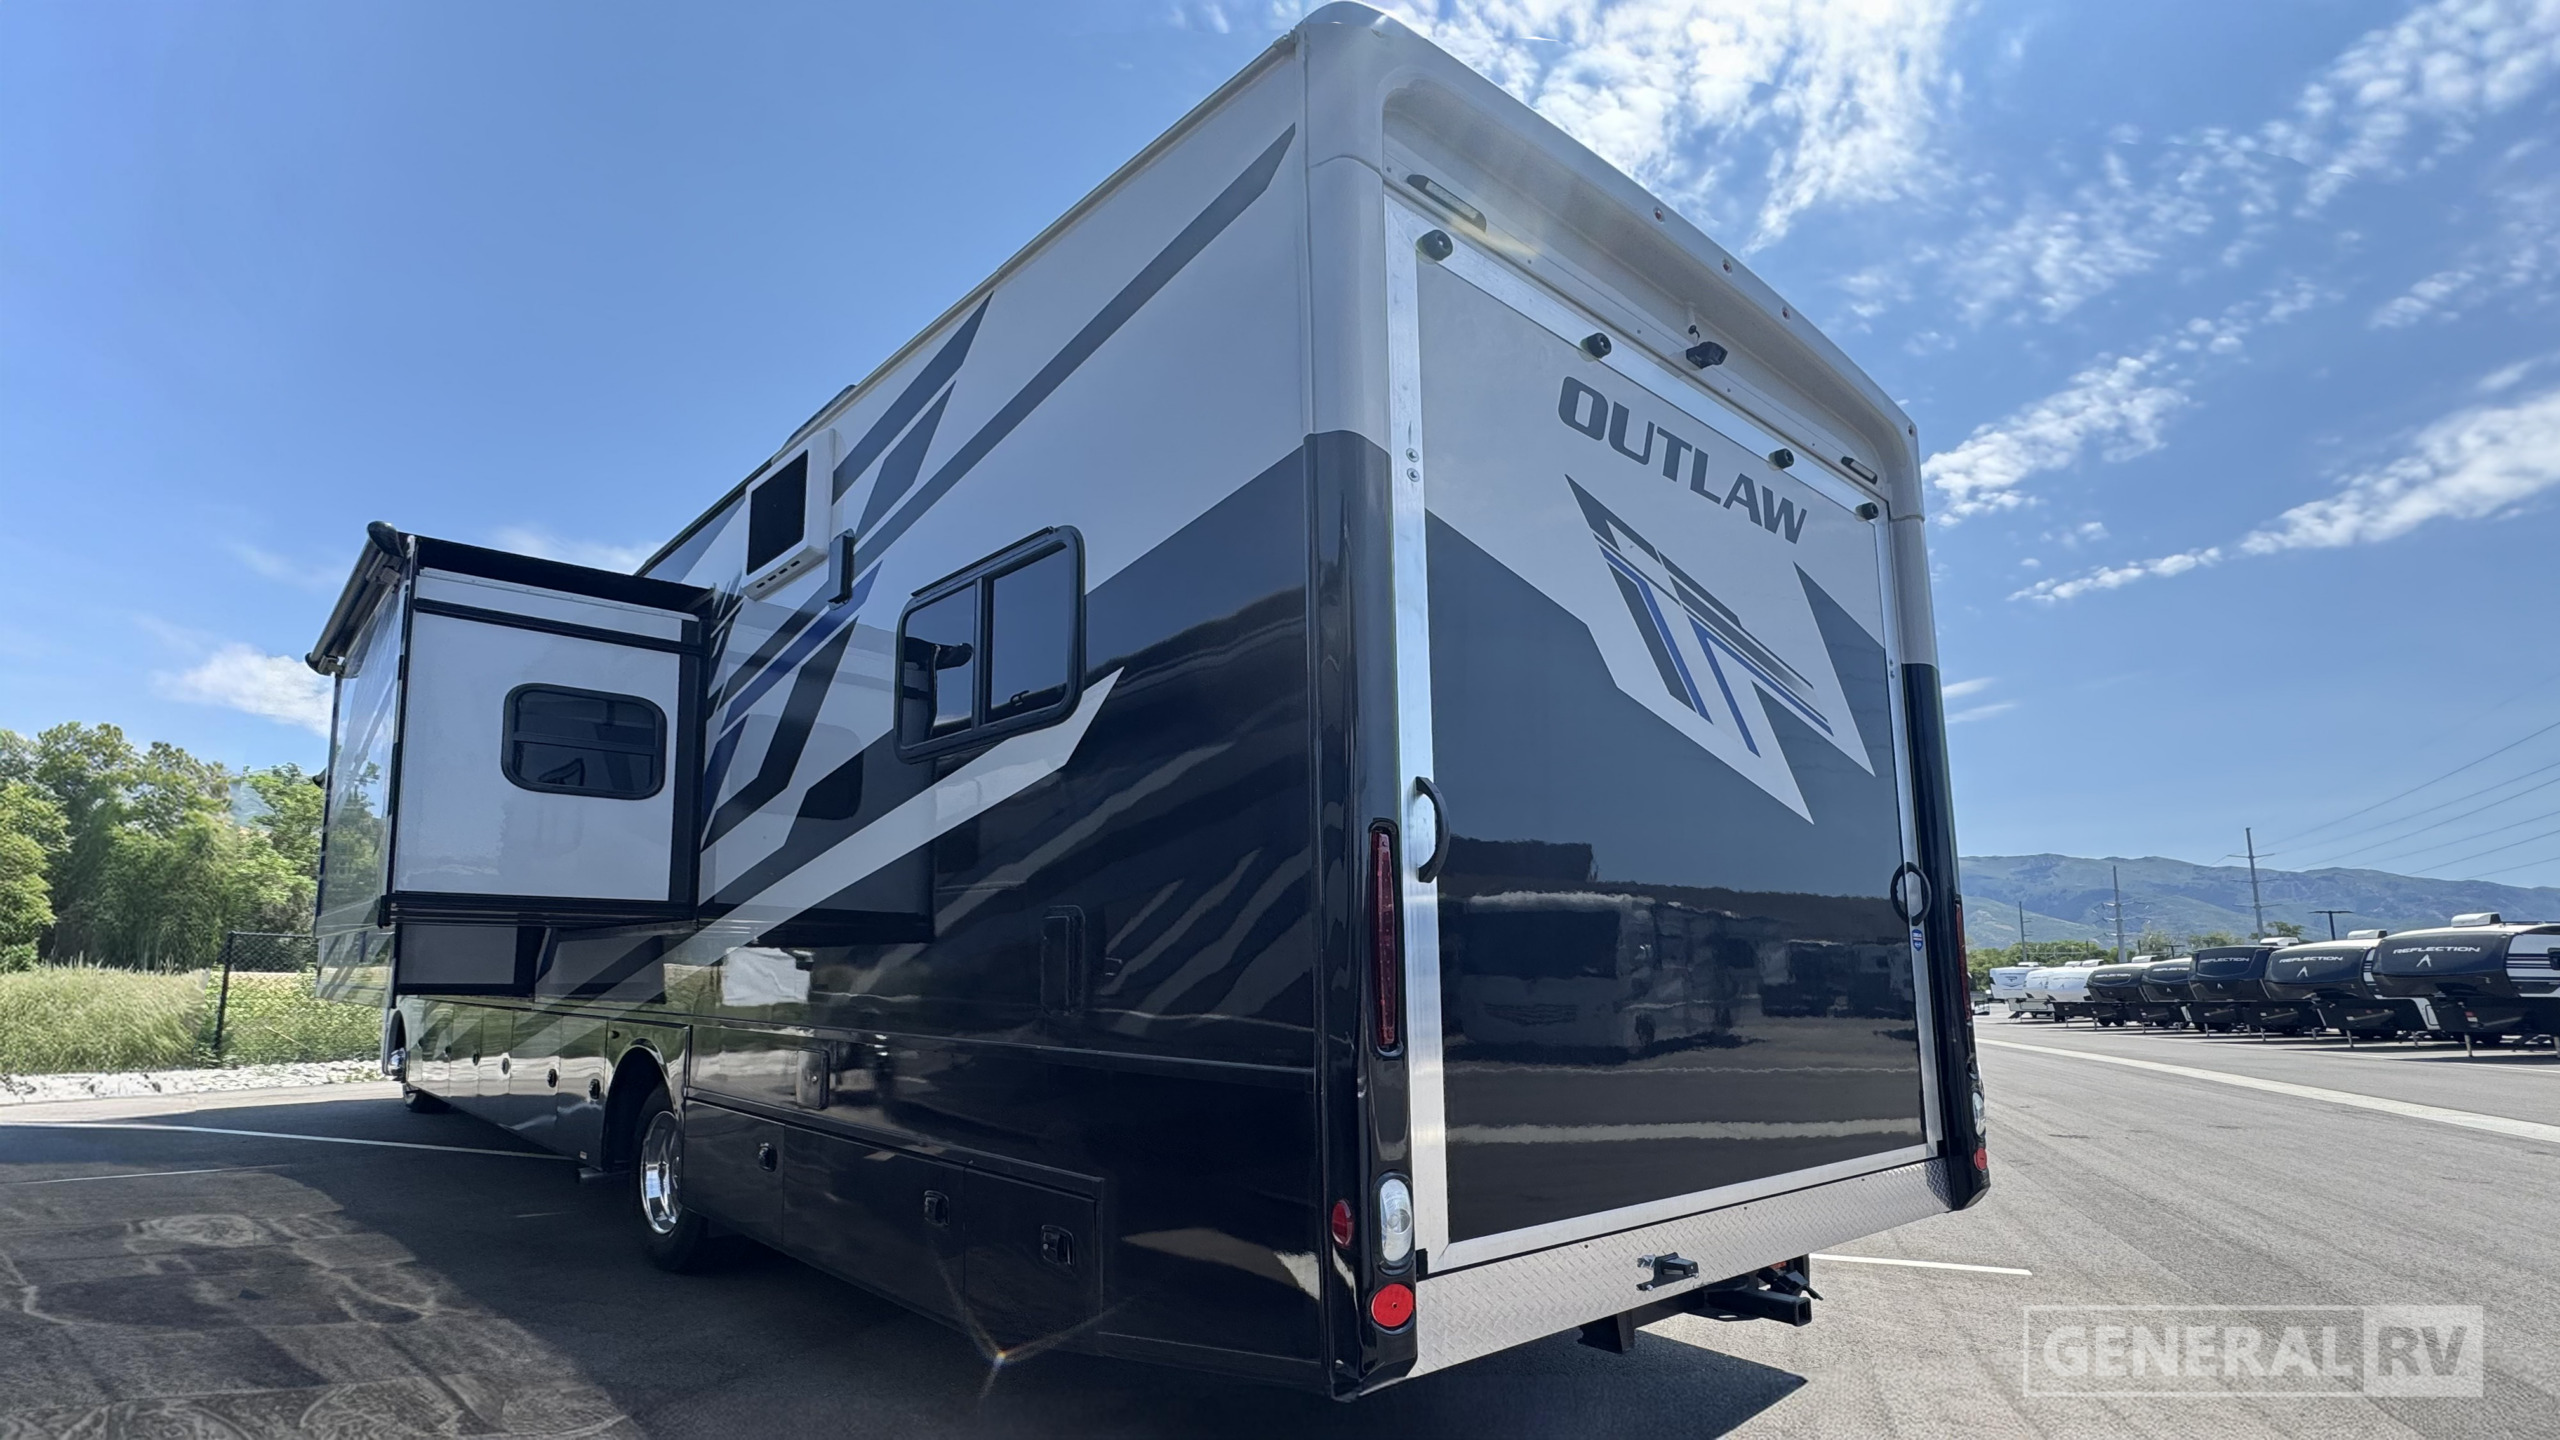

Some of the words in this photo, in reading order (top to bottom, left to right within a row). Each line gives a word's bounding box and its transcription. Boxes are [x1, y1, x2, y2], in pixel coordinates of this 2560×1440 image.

[1558, 376, 1807, 544] OUTLAW
[2393, 946, 2480, 954] REFLECTION
[2279, 956, 2343, 964] REFLECTION
